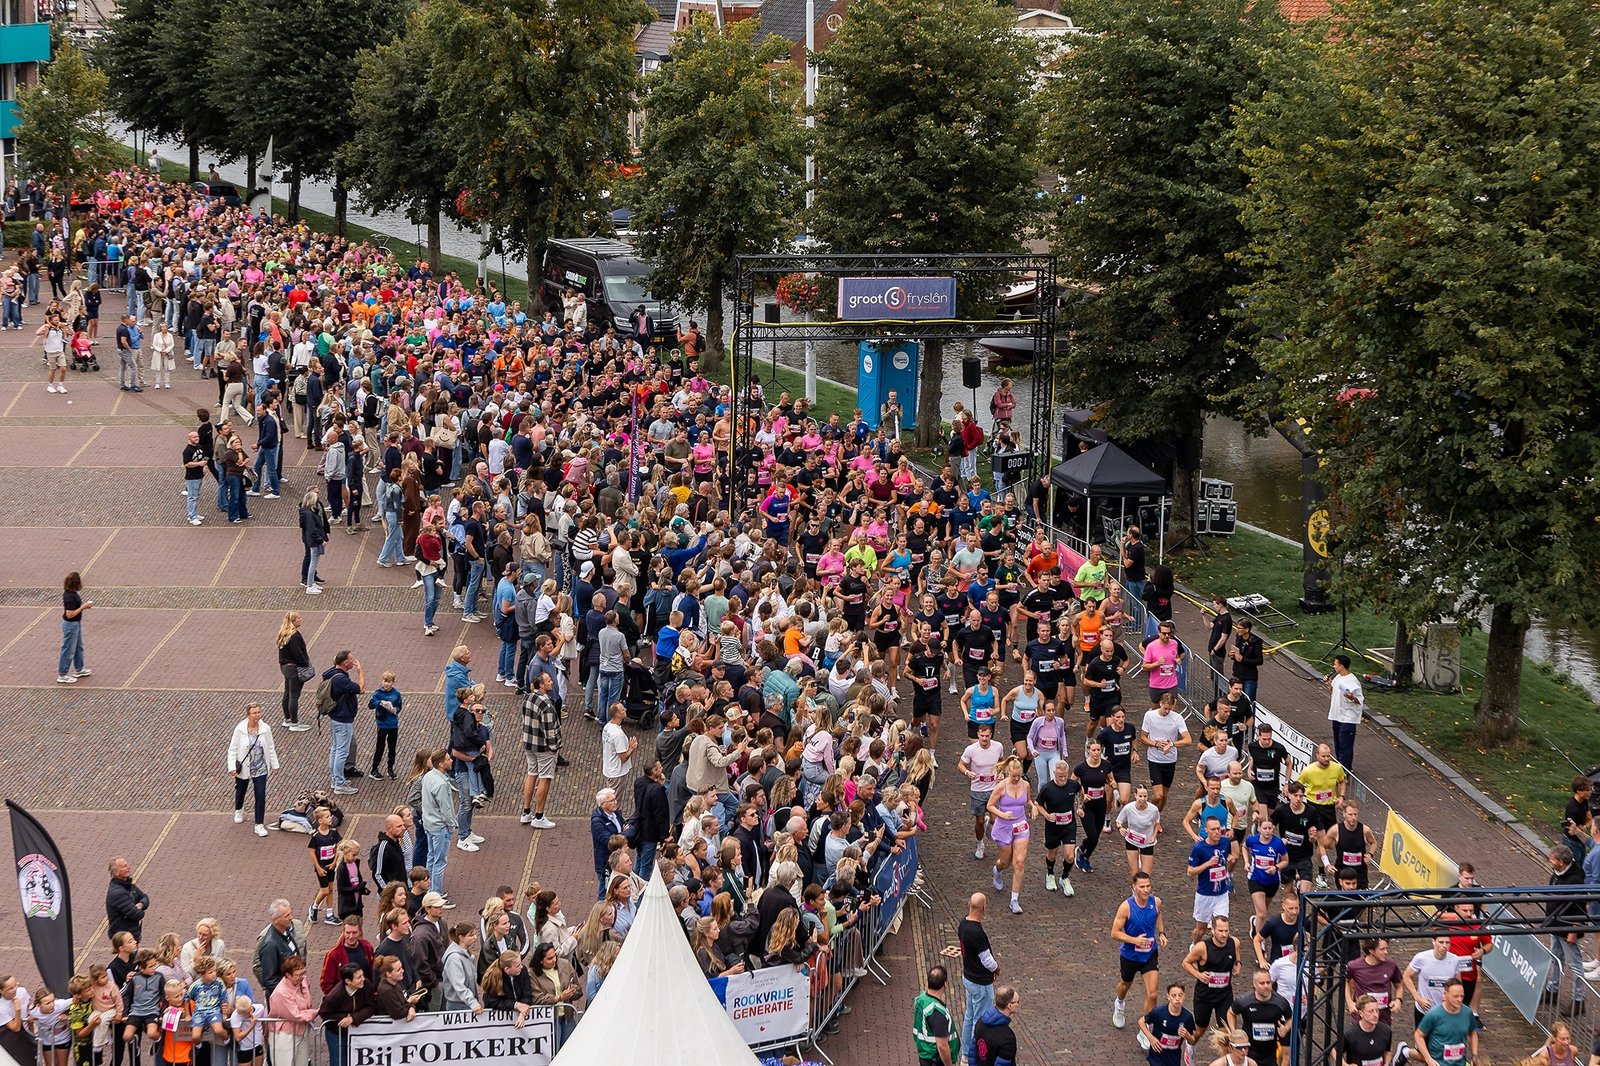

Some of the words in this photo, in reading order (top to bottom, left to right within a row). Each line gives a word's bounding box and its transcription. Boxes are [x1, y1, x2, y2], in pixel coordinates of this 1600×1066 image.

[849, 294, 883, 309] groot
[906, 291, 948, 306] fryslân
[925, 665, 936, 677] 17
[1402, 851, 1431, 882] SPORT
[1502, 940, 1511, 957] U
[734, 987, 794, 1008] ROOKVRIJE
[443, 1011, 479, 1025] WALK
[488, 1010, 514, 1022] RUN
[733, 999, 793, 1020] GENERATIE
[354, 1046, 392, 1066] Bij
[399, 1036, 547, 1064] FOLKERT
